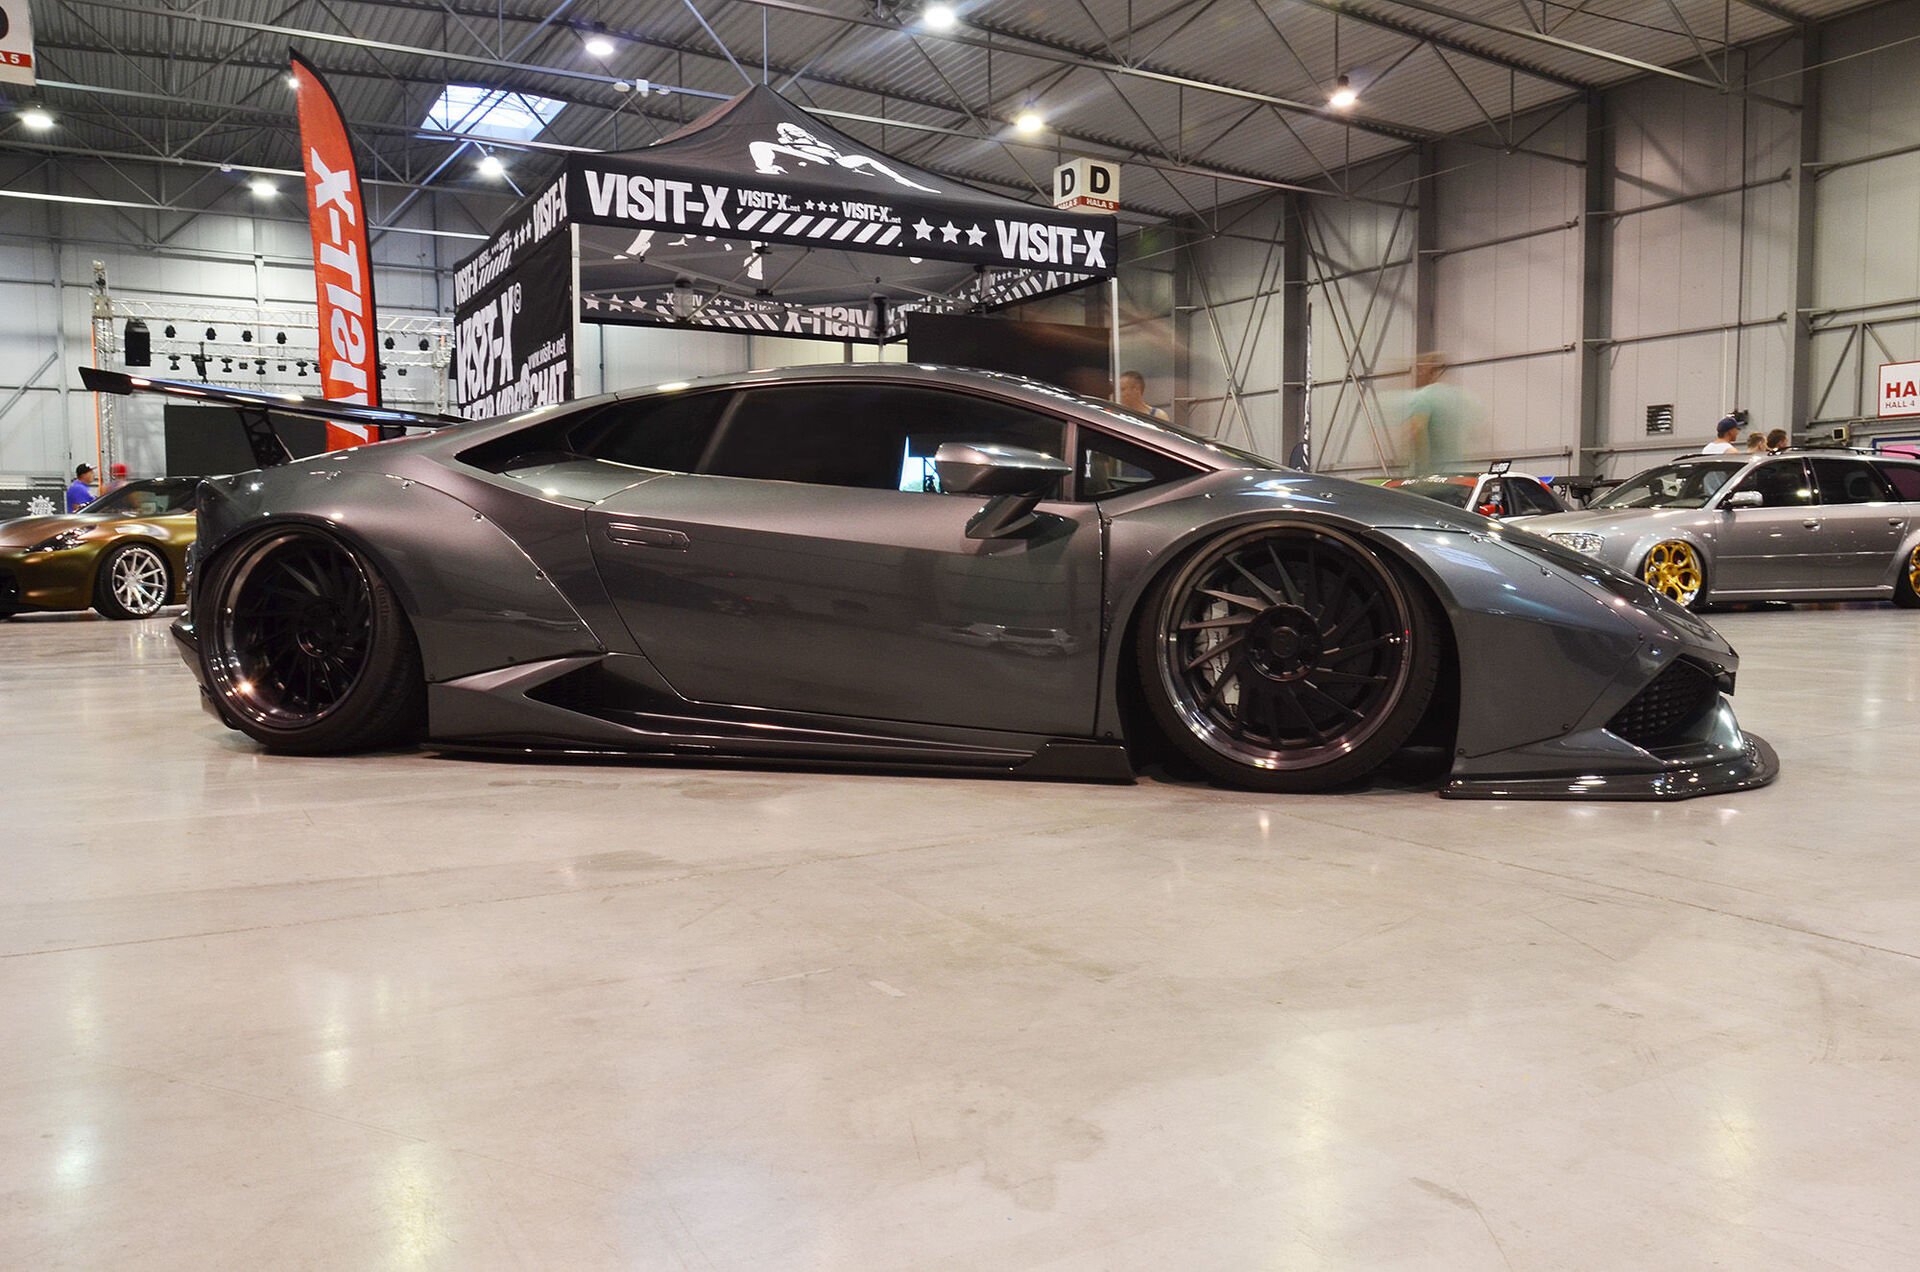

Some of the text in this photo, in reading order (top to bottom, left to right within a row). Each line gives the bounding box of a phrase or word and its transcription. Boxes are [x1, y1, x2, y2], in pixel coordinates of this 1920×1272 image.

[1061, 167, 1075, 197] D
[1090, 165, 1110, 193] D
[533, 172, 567, 243] VISIT-X
[584, 170, 731, 229] VISIT-X
[1086, 198, 1107, 208] HALA
[995, 219, 1106, 268] VISIT-X
[1886, 381, 1920, 398] HA
[1885, 401, 1907, 409] HALL
